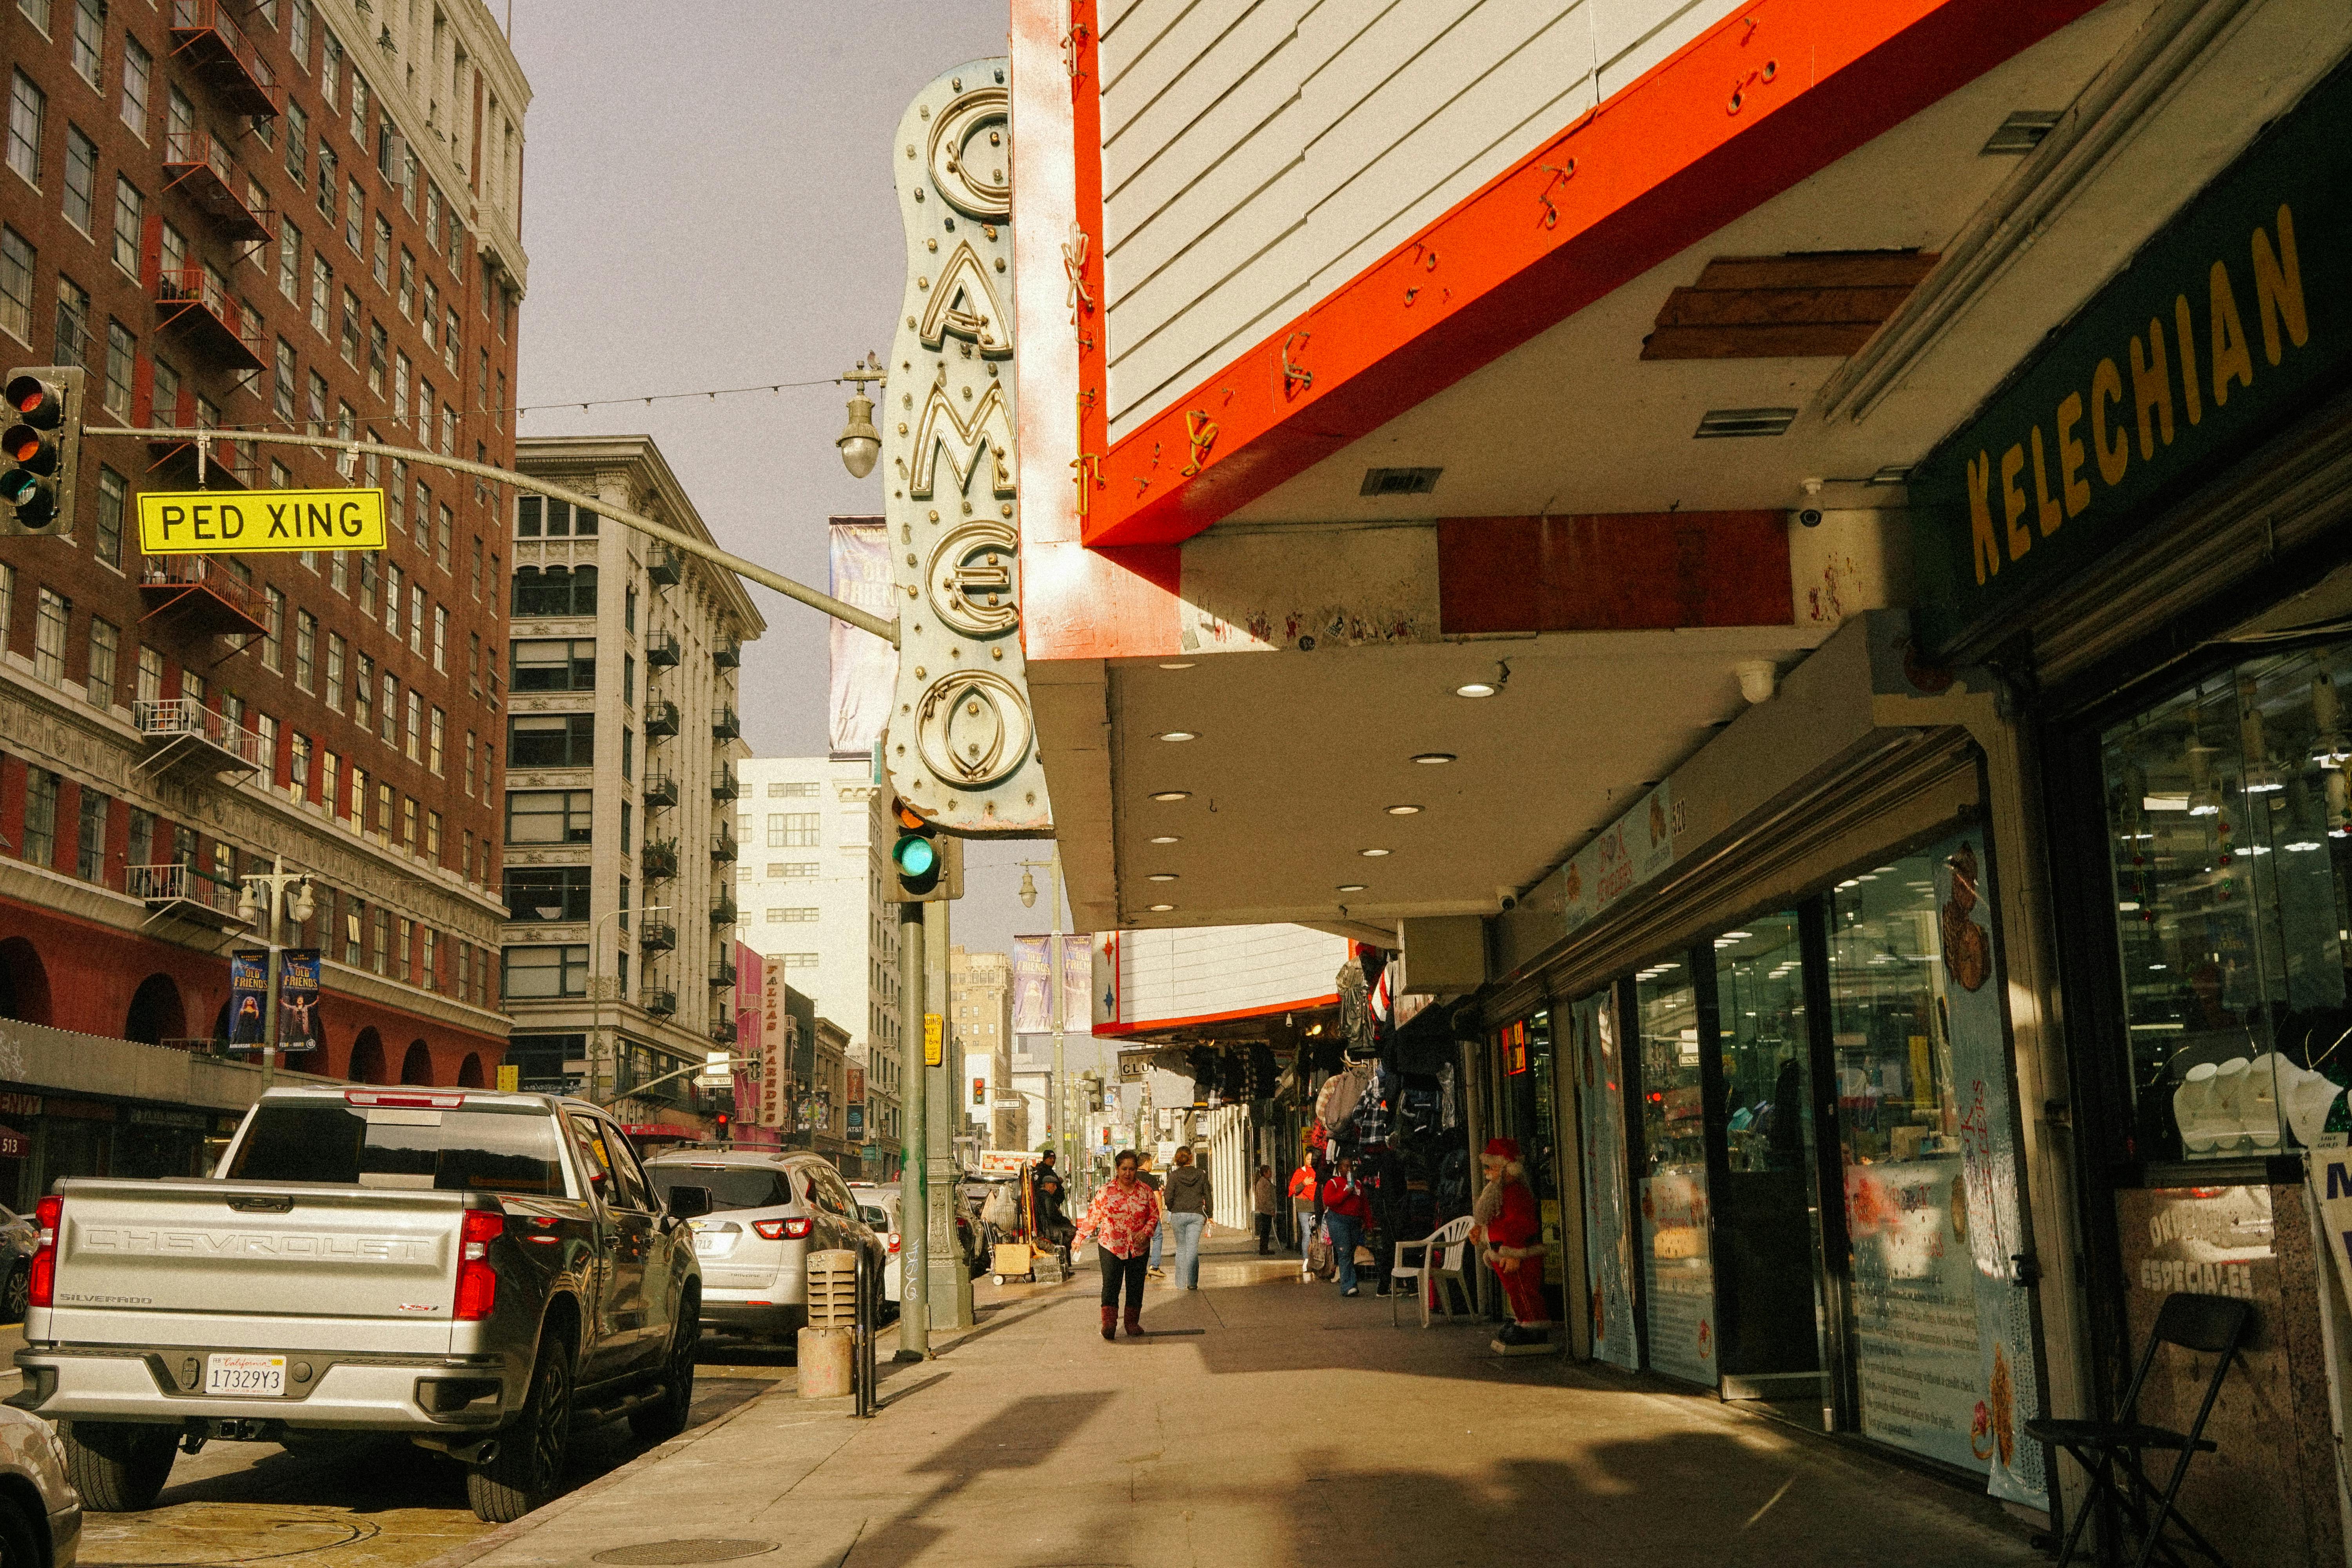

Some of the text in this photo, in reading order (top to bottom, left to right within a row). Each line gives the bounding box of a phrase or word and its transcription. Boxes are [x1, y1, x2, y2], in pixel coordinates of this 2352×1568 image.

[1967, 203, 2308, 586] KELECHIAN
[910, 87, 1033, 785] CAMEO
[162, 502, 362, 540] PED XING
[838, 579, 897, 607] FRIEN
[1671, 798, 1686, 837] 528
[1027, 953, 1042, 963] OLD
[1076, 952, 1090, 961] OLD
[1017, 960, 1050, 973] FRIENDS
[1065, 959, 1091, 971] FRIEN
[246, 968, 260, 978] OLD
[295, 967, 309, 977] OLD
[234, 976, 268, 989] FRIENDS
[284, 975, 318, 988] FRIENDS
[924, 1017, 940, 1025] ADING
[764, 965, 778, 1122] FALLAS PAREDES
[1123, 1063, 1149, 1074] CLU
[2, 1138, 17, 1153] 513
[83, 1229, 430, 1261] CHEVROLET
[60, 1294, 152, 1304] SILVERADO
[225, 1357, 272, 1369] California
[212, 1370, 279, 1388] 17329Y3
